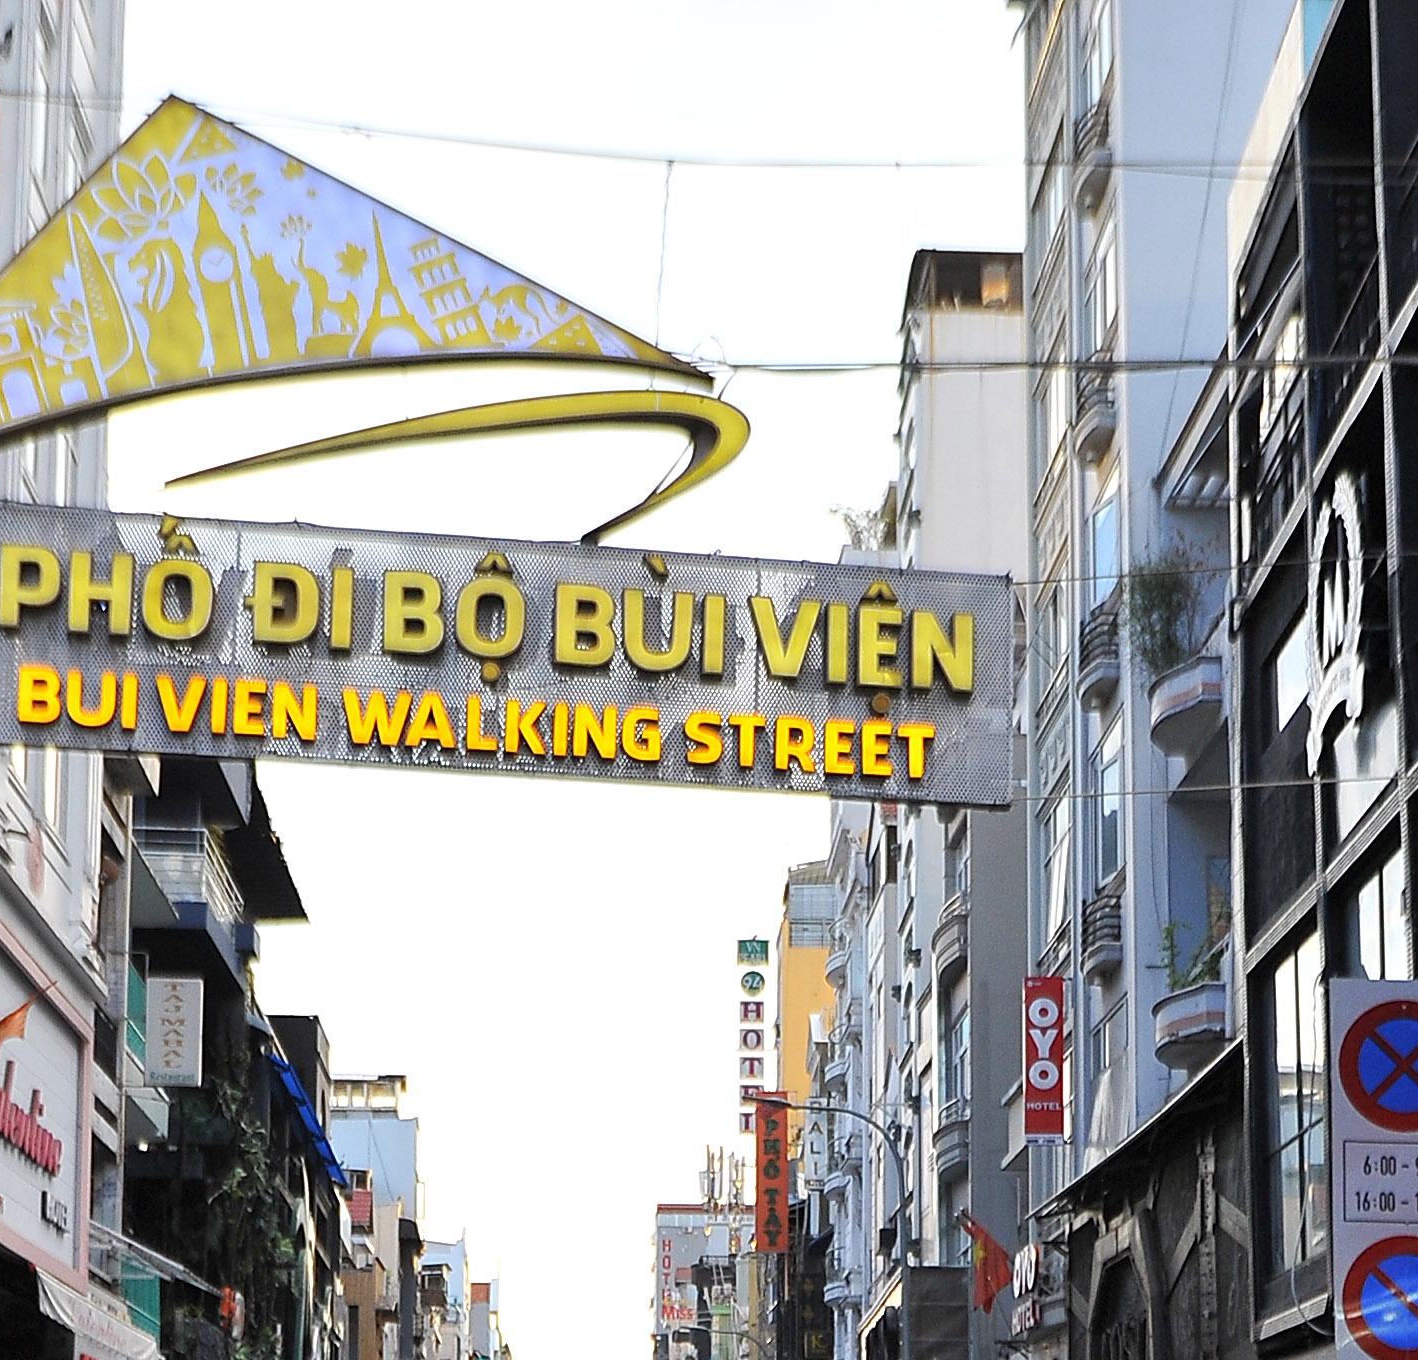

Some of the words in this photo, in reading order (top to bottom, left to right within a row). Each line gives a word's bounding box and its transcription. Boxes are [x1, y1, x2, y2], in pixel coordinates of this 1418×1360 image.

[244, 561, 354, 651] ĐI
[382, 552, 526, 684] BỘ
[553, 555, 728, 676] BÙI
[751, 580, 975, 714] VIỆN
[17, 663, 138, 732] BUI
[156, 672, 318, 743] VIEN
[342, 688, 662, 762] WALKING
[684, 709, 936, 780] STREET
[742, 974, 765, 993] 94
[1028, 998, 1059, 1090] OYO
[1027, 1102, 1062, 1111] HOTEL
[1363, 1155, 1397, 1177] 6:00
[1355, 1191, 1397, 1213] 16:00
[1013, 1244, 1037, 1299] OYO
